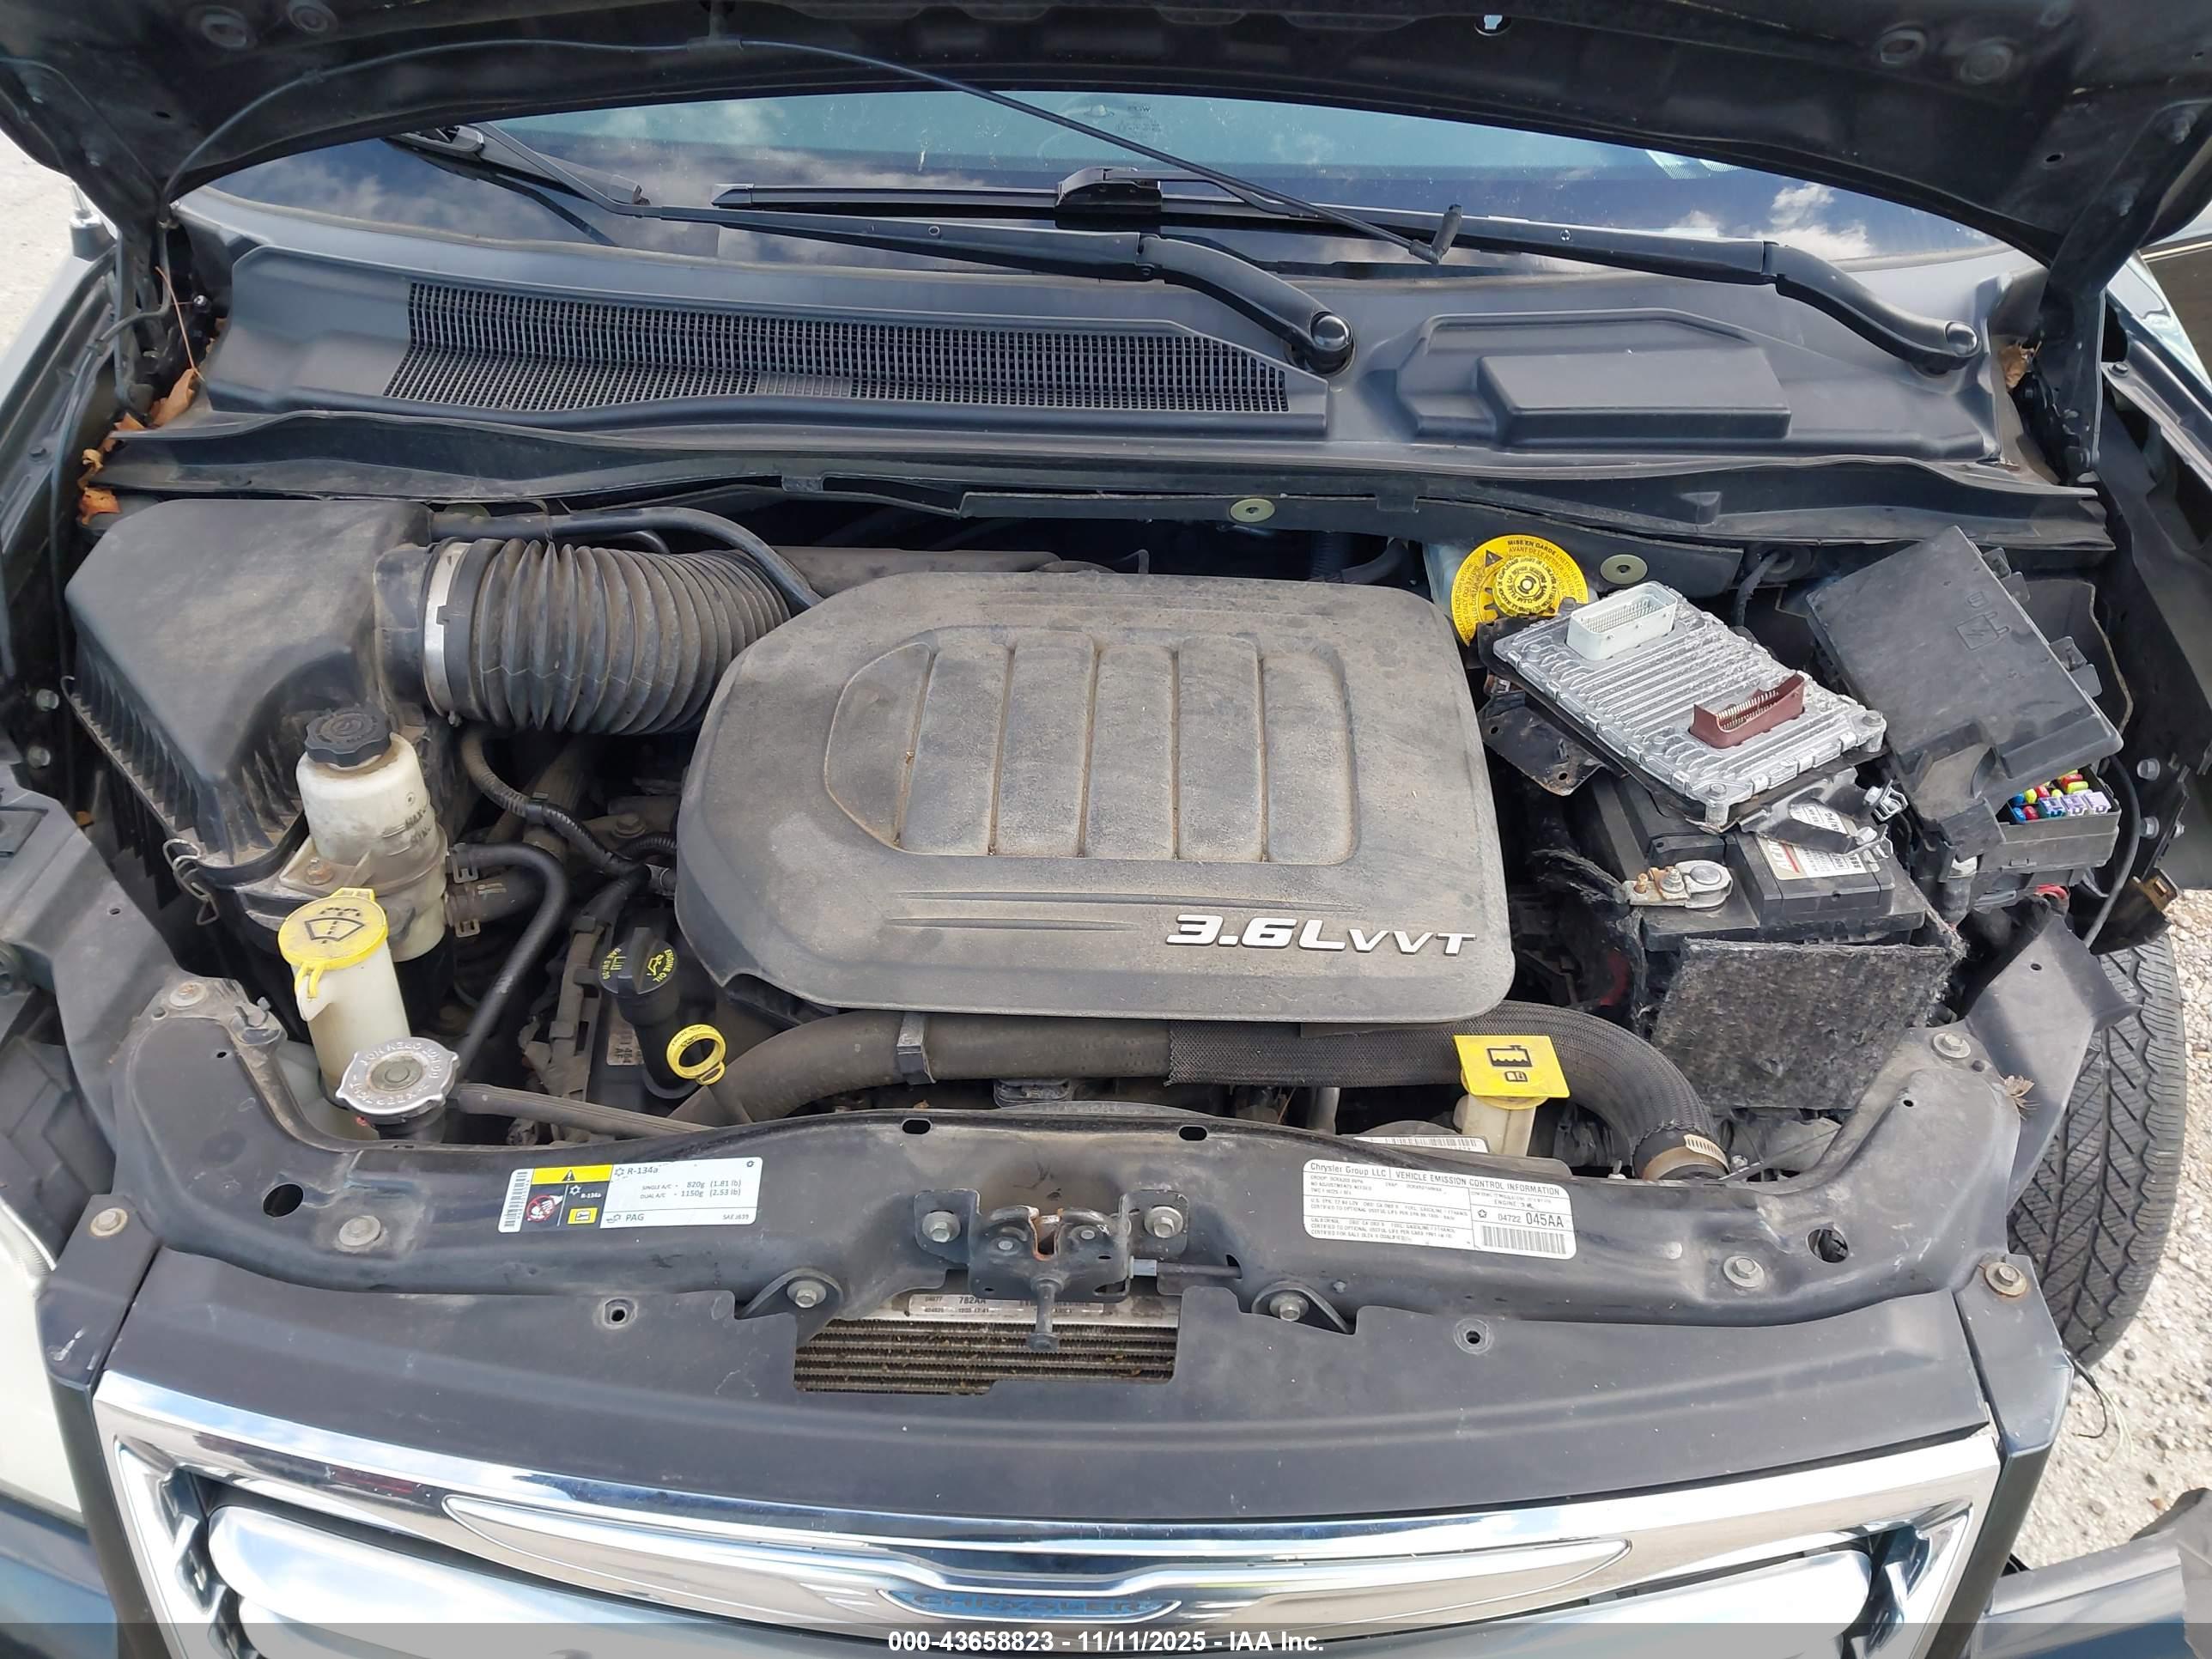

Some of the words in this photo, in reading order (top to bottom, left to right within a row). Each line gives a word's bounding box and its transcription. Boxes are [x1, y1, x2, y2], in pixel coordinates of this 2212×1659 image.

[1535, 542, 1557, 555] GARDE
[661, 949, 674, 972] ENGINE
[653, 972, 667, 982] OIL
[710, 1180, 729, 1188] (1.81
[1310, 1163, 1342, 1173] Chrysler
[1346, 1166, 1369, 1176] Group
[1372, 1168, 1387, 1177] LLC
[1395, 1170, 1427, 1182] VEHICLE
[1430, 1175, 1467, 1185] EMISSION
[1469, 1179, 1504, 1189] CONTROL
[1507, 1183, 1559, 1195] INFORMATION
[731, 1188, 741, 1197] lb)
[1498, 1213, 1522, 1223] 04722
[1526, 1212, 1564, 1228] 045AA
